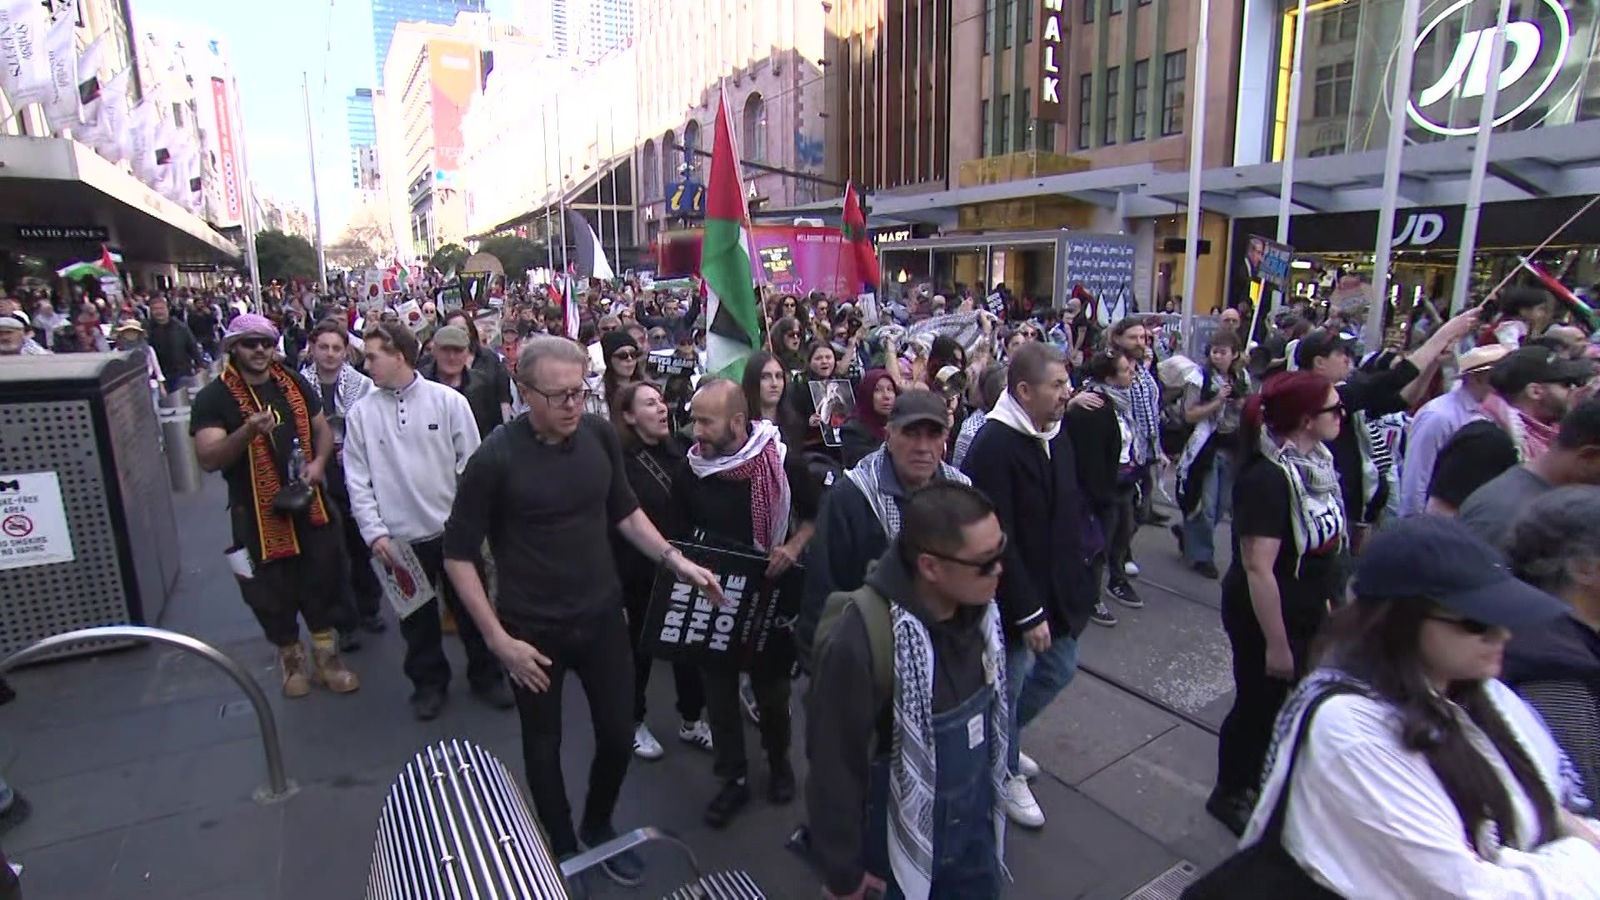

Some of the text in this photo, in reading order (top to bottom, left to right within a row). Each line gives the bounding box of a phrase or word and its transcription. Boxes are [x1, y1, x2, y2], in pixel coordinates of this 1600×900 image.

[1419, 21, 1541, 107] JD
[21, 229, 105, 237] DAVID JONES
[878, 231, 909, 243] MART
[1392, 213, 1444, 246] JD
[10, 537, 48, 546] SMOKING
[15, 545, 46, 553] VAPING
[660, 572, 692, 643] BRIN
[709, 575, 747, 651] HOME
